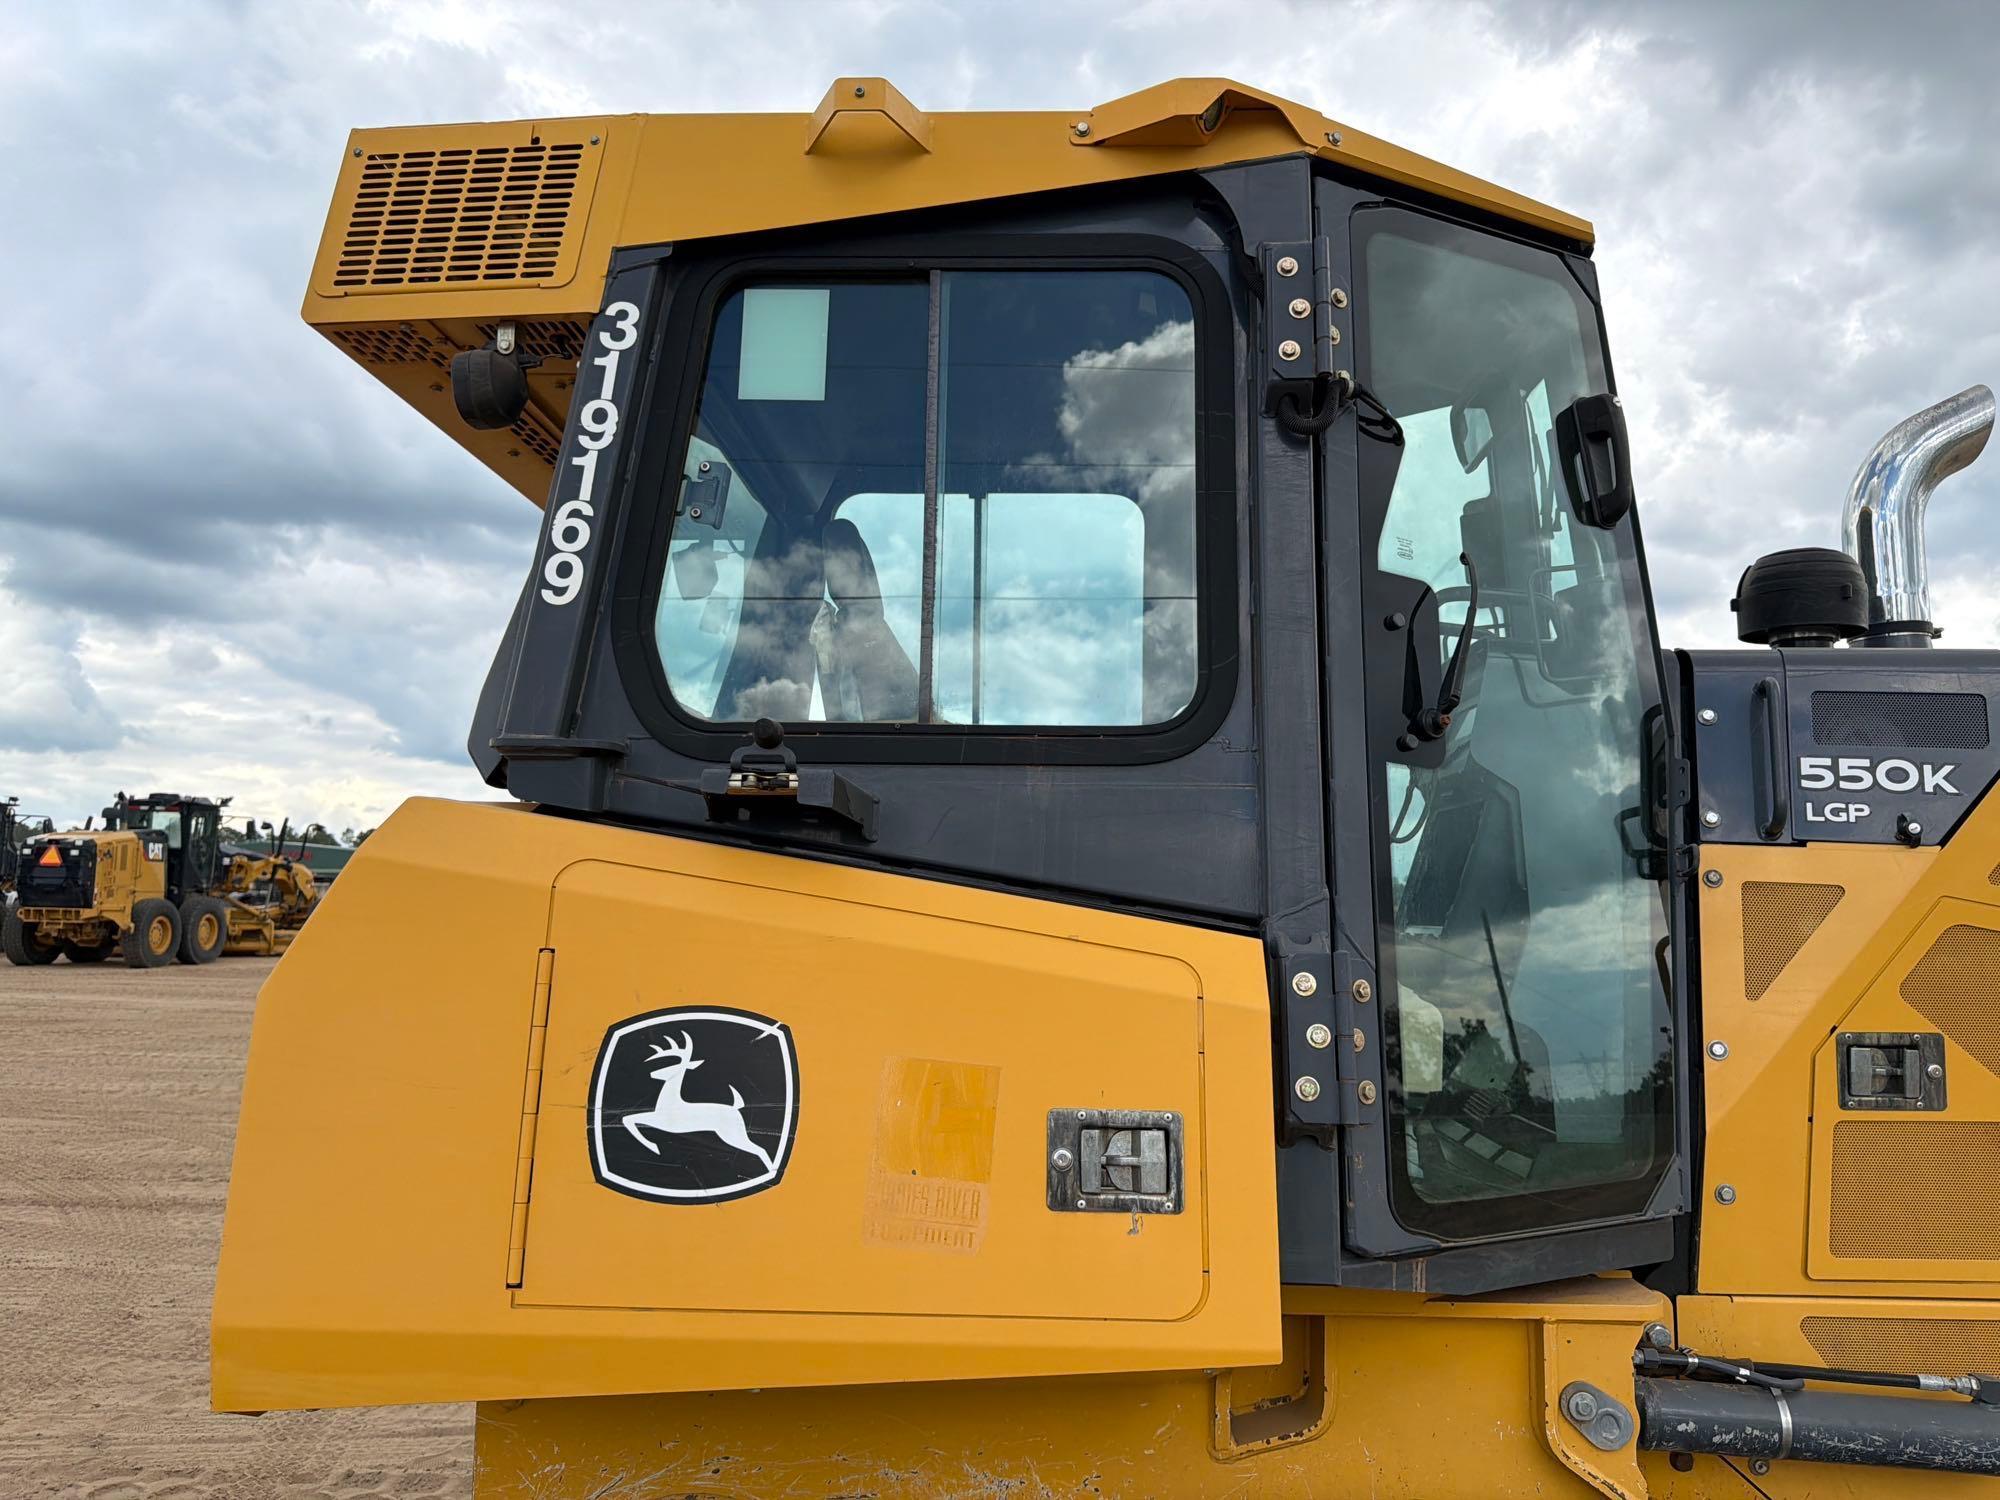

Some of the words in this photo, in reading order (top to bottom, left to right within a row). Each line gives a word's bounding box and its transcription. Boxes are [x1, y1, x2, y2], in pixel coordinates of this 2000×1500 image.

[541, 301, 640, 605] 319169
[1800, 757, 1959, 794] 550K
[1806, 802, 1871, 822] LGP
[148, 842, 163, 860] CAT
